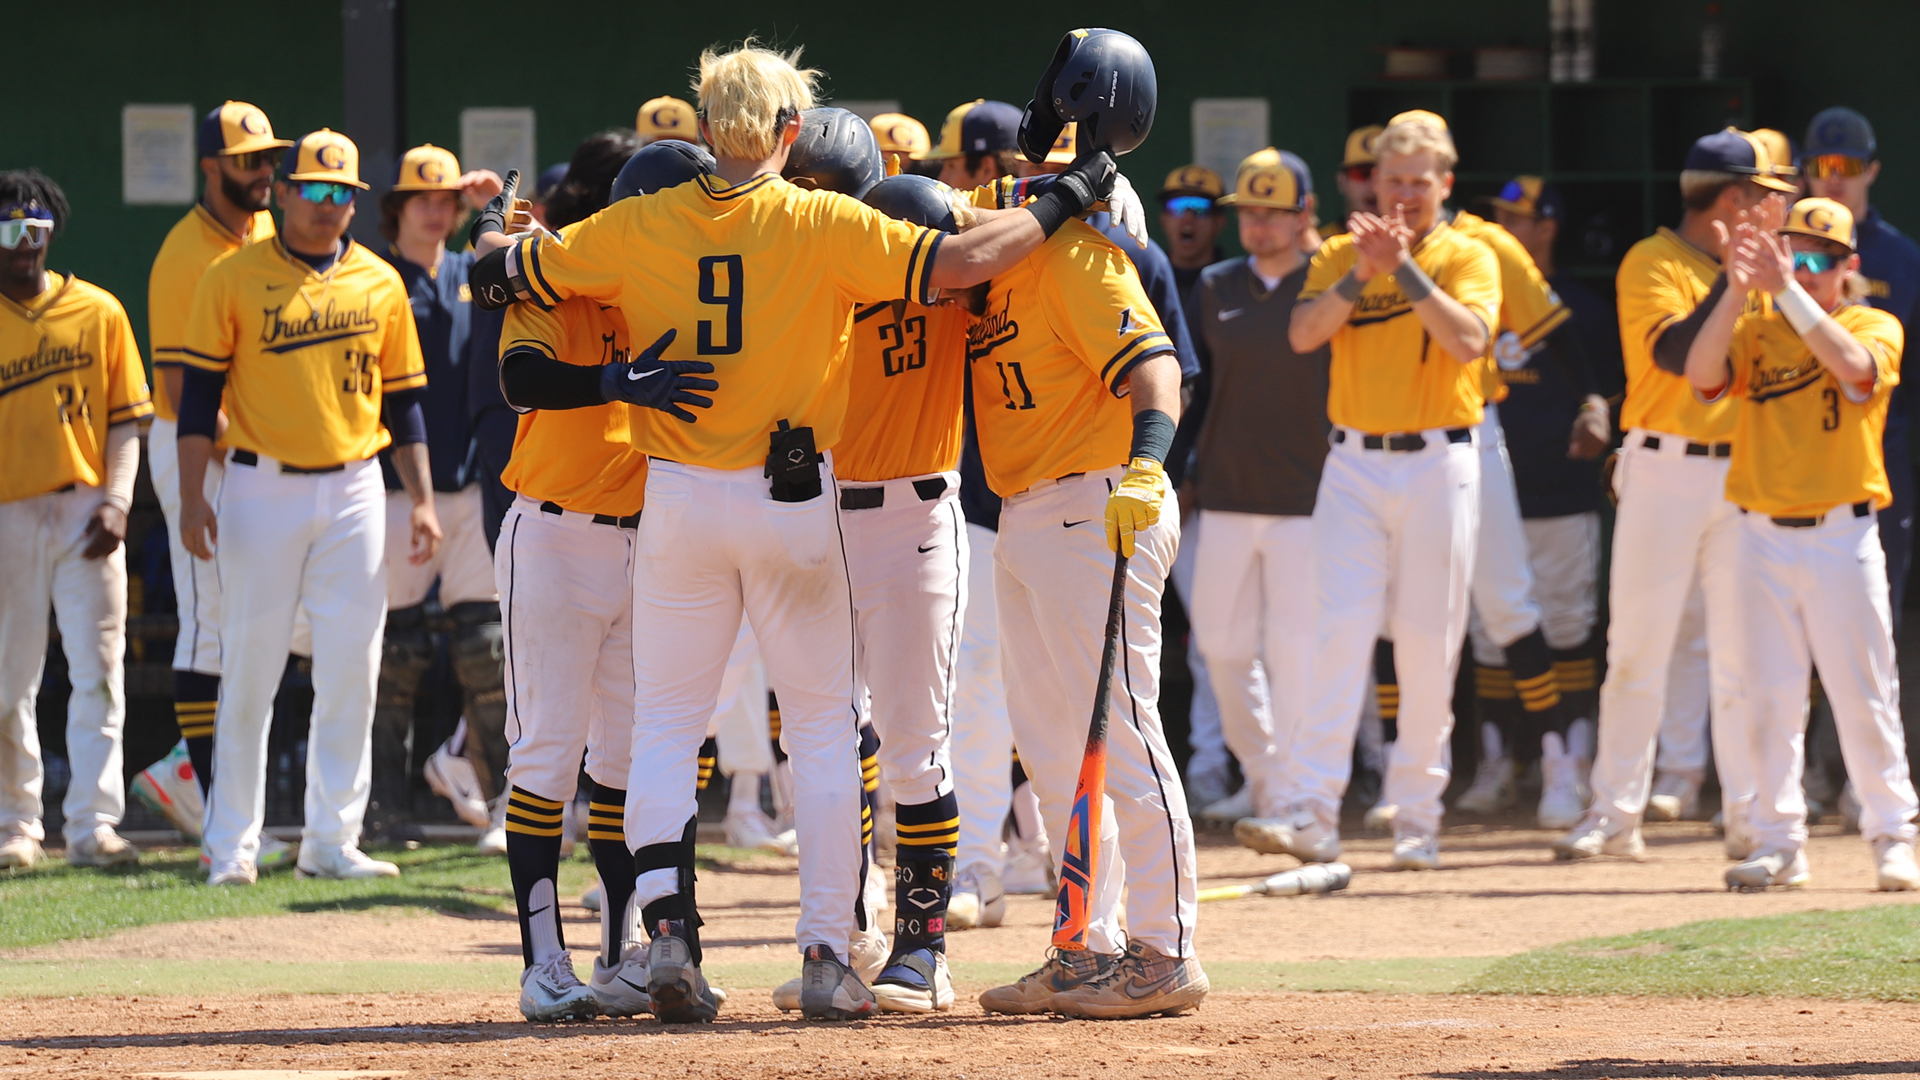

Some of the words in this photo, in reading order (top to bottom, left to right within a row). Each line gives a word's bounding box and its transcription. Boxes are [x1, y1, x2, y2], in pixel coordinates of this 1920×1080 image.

[651, 106, 681, 129] G
[316, 144, 346, 170] G
[417, 161, 444, 184] G
[1248, 172, 1277, 198] G
[1805, 209, 1833, 232] G
[259, 291, 378, 344] Graceland
[697, 254, 744, 355] 9
[878, 315, 926, 377] 23
[343, 350, 379, 395] 35
[996, 362, 1036, 410] 11
[1823, 388, 1839, 431] 3
[927, 917, 943, 933] 23
